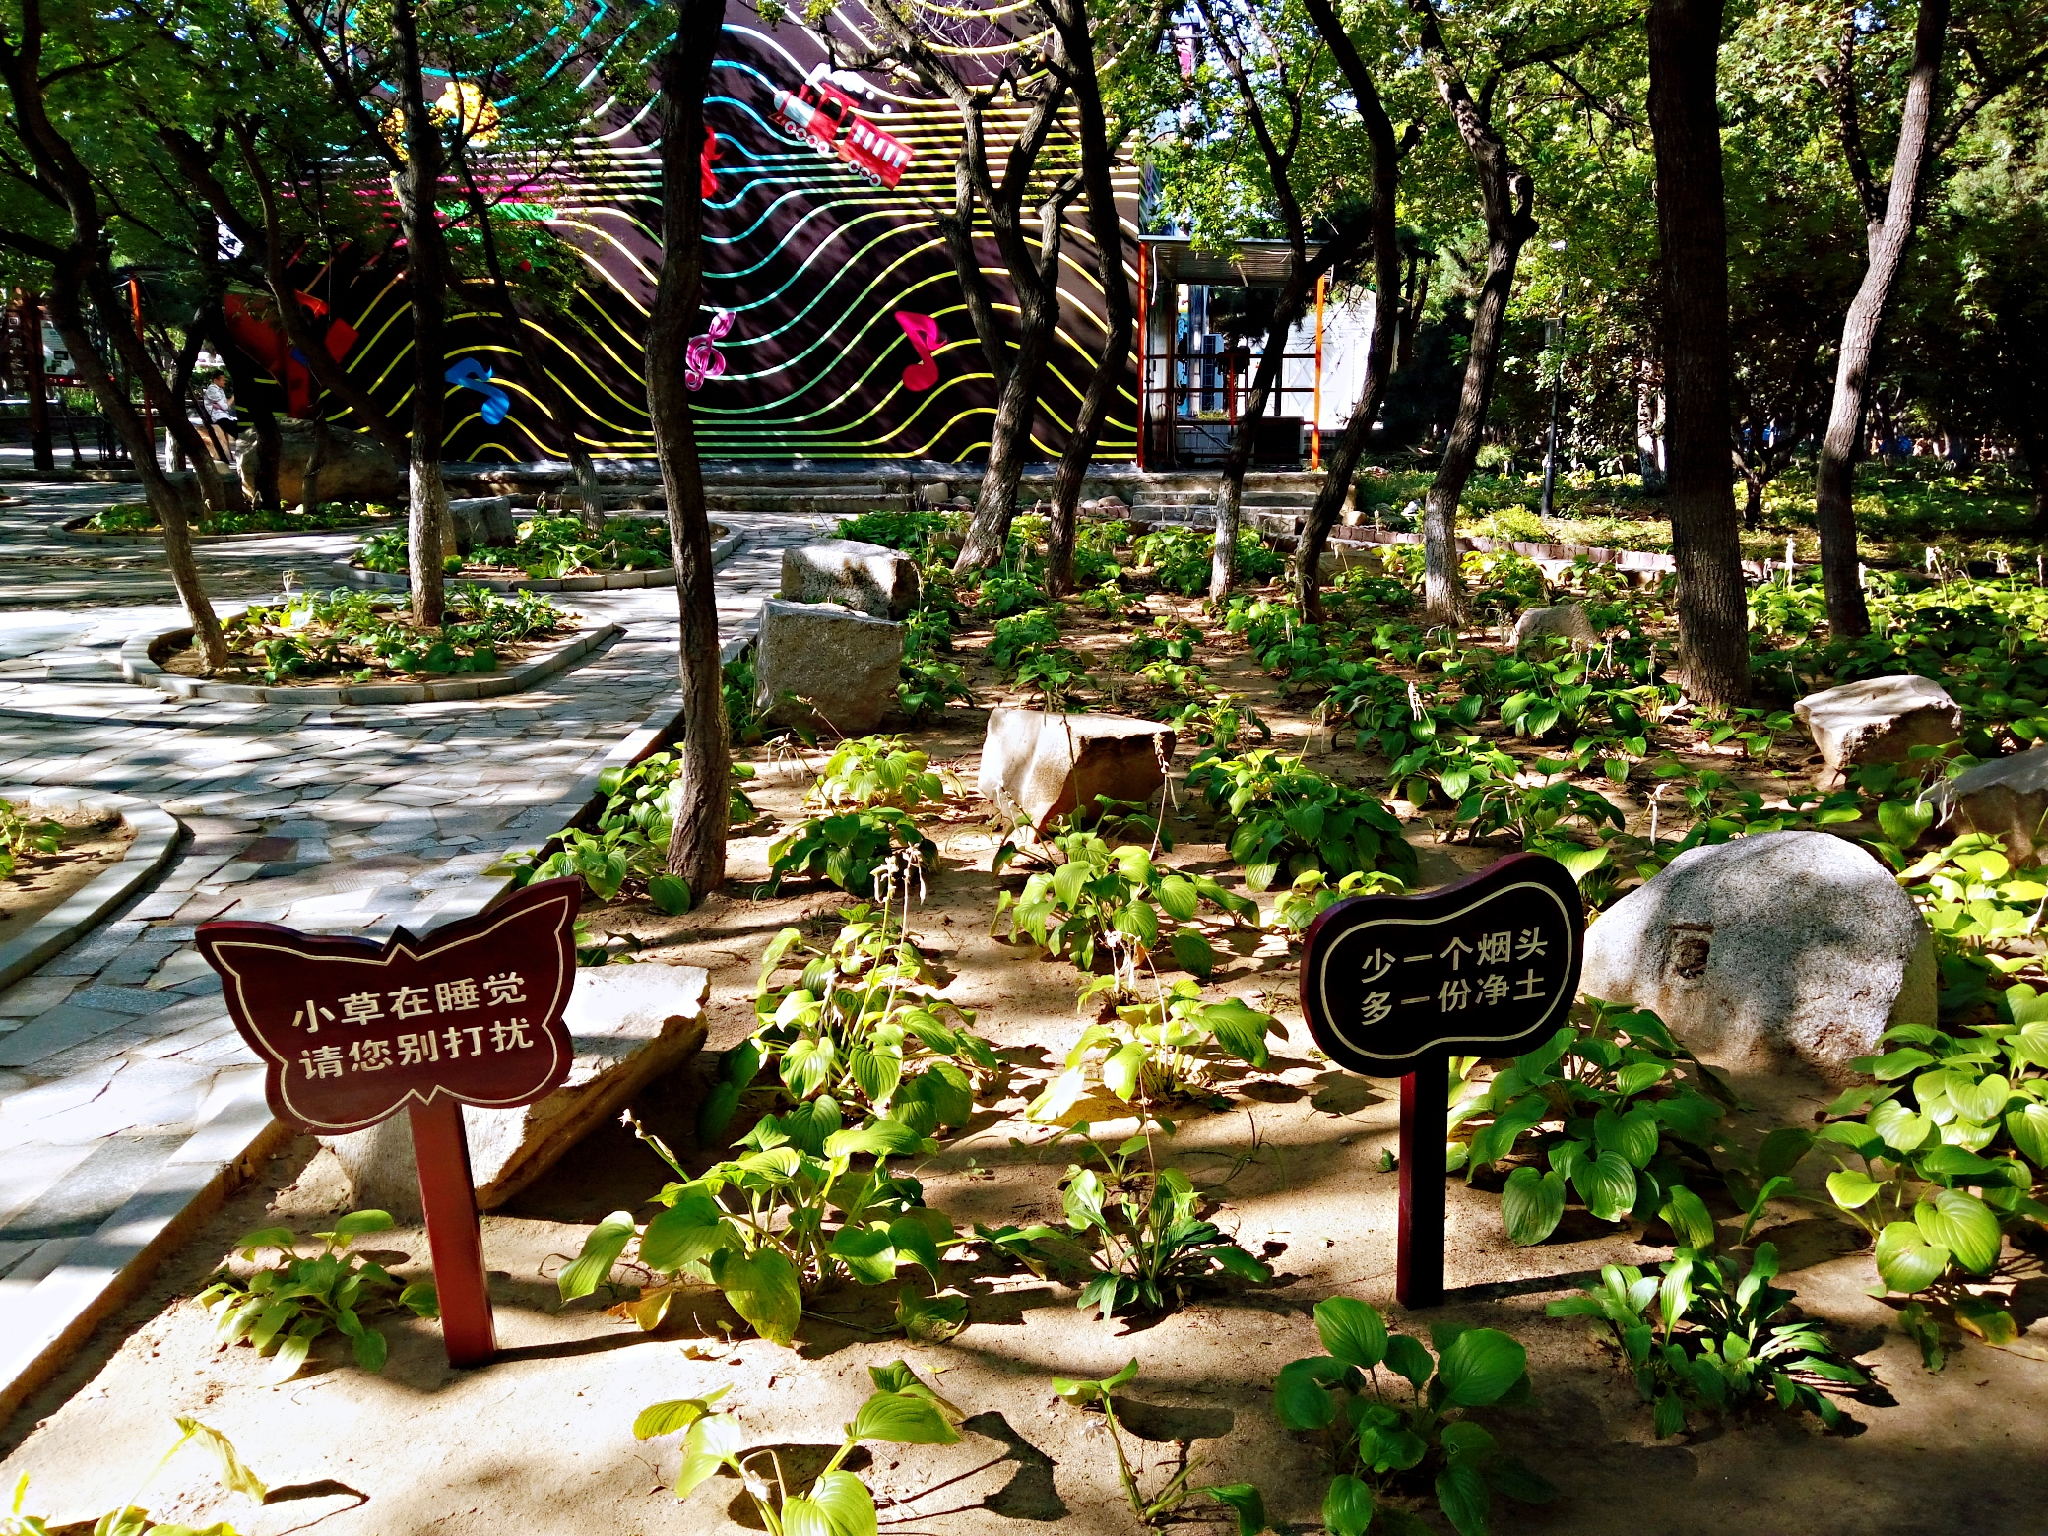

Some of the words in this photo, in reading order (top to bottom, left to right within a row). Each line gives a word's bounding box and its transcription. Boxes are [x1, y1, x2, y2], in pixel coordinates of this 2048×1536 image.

[1361, 926, 1548, 984] 少一个烟头
[291, 971, 528, 1033] 小草在睡觉
[1361, 968, 1546, 1026] 多一份净土
[297, 1016, 535, 1080] 请您别打扰
